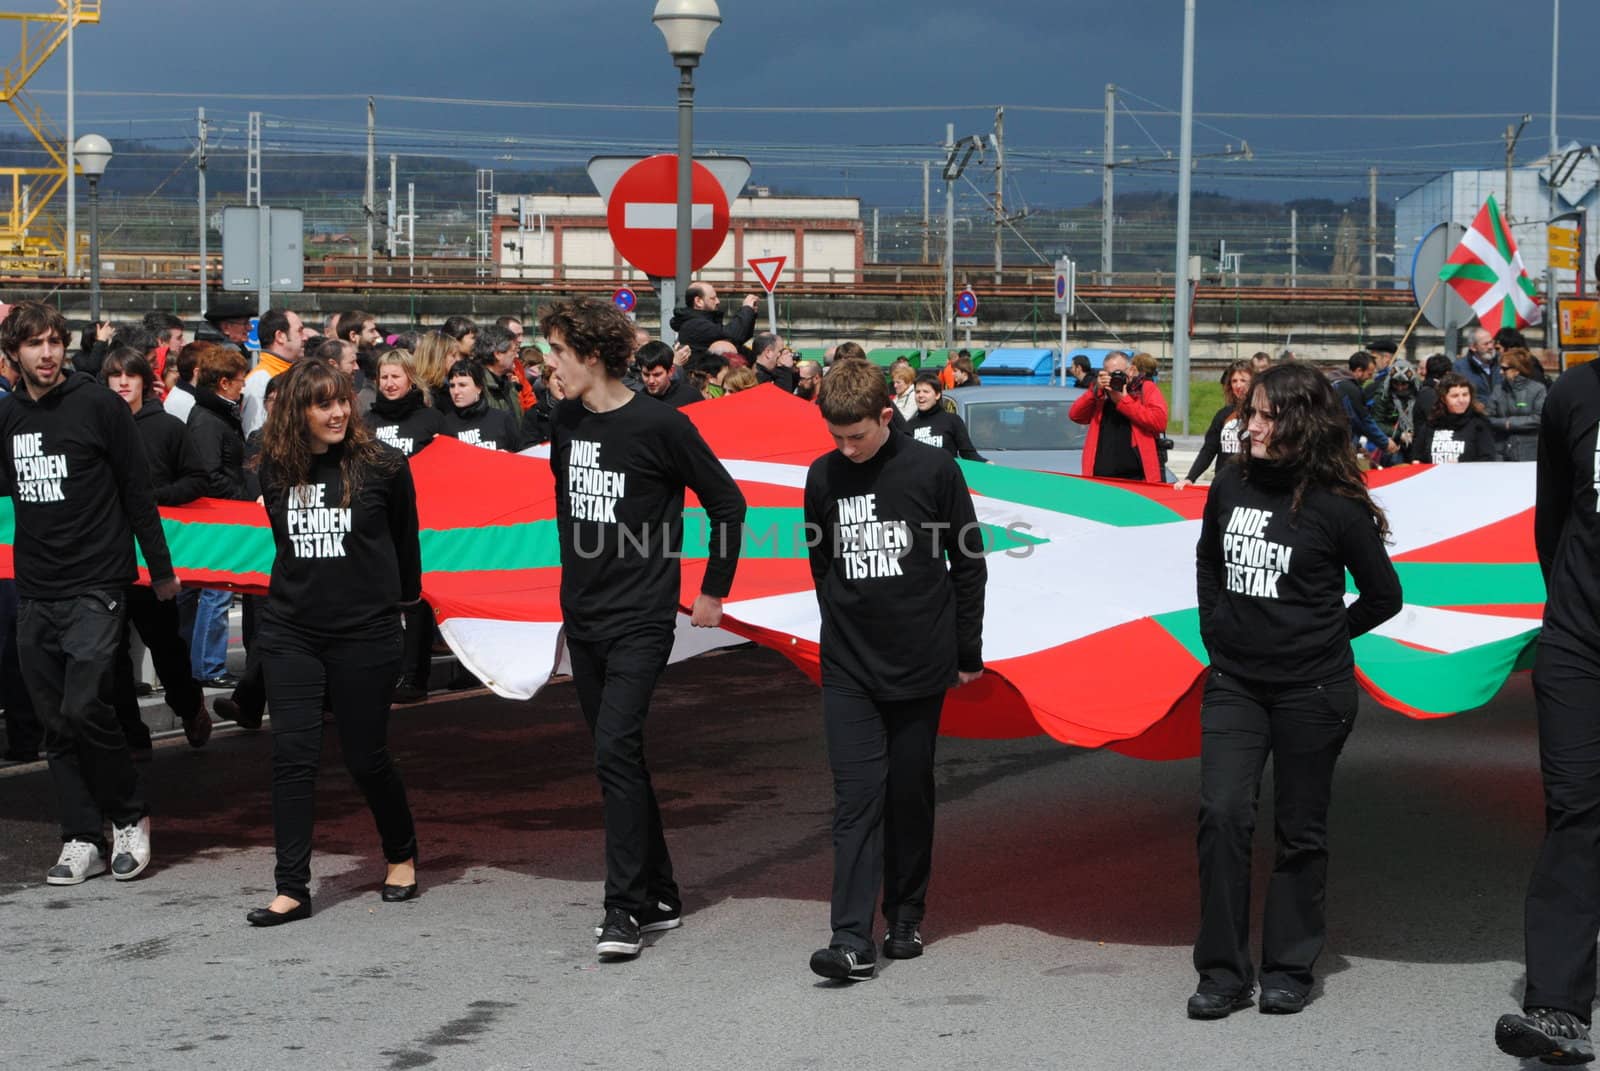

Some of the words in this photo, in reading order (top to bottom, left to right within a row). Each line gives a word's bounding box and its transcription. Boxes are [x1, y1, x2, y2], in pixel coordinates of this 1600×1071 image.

[13, 432, 44, 458] INDE
[569, 439, 602, 469] INDE
[1431, 440, 1466, 454] PENDEN
[15, 454, 68, 481] PENDEN
[568, 465, 626, 498] PENDEN
[17, 478, 66, 502] TISTAK
[288, 483, 326, 509] INDE
[287, 507, 352, 535] PENDEN
[568, 491, 617, 524] TISTAK
[837, 493, 878, 526] INDE
[1226, 506, 1273, 539] INDE
[289, 533, 346, 558] TISTAK
[840, 520, 908, 552] PENDEN
[842, 548, 904, 580] TISTAK
[1223, 533, 1293, 575] PENDEN
[1225, 562, 1282, 599] TISTAK
